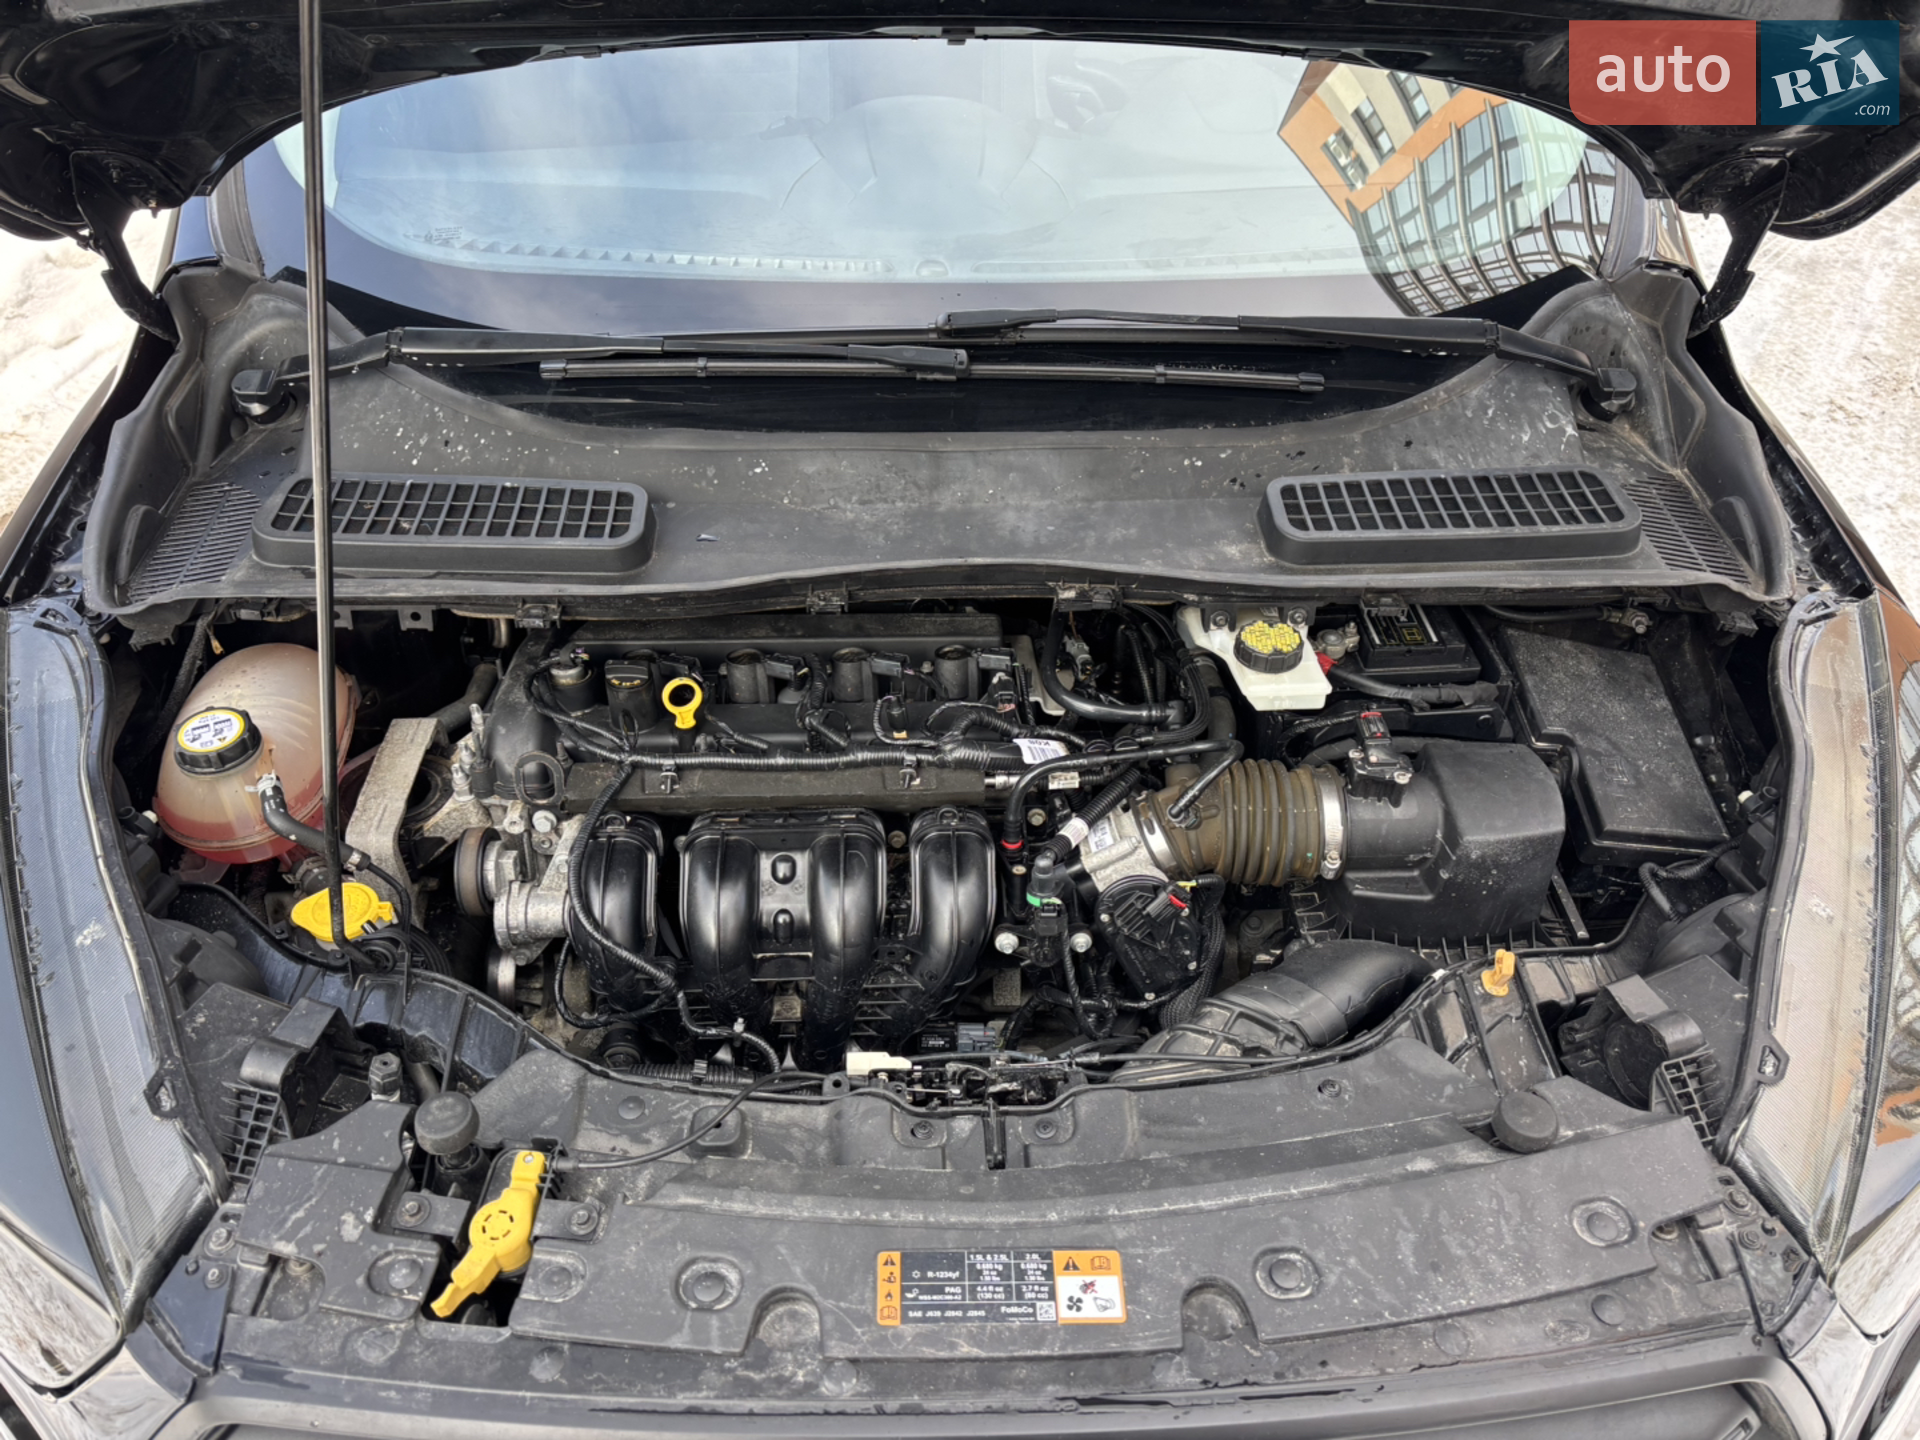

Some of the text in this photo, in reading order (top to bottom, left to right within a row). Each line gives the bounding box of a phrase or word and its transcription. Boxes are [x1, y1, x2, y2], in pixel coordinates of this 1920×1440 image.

[994, 1263, 1004, 1271] kg
[1038, 1263, 1048, 1271] kg
[927, 1270, 960, 1280] R-1234yf
[944, 1286, 962, 1294] PAG
